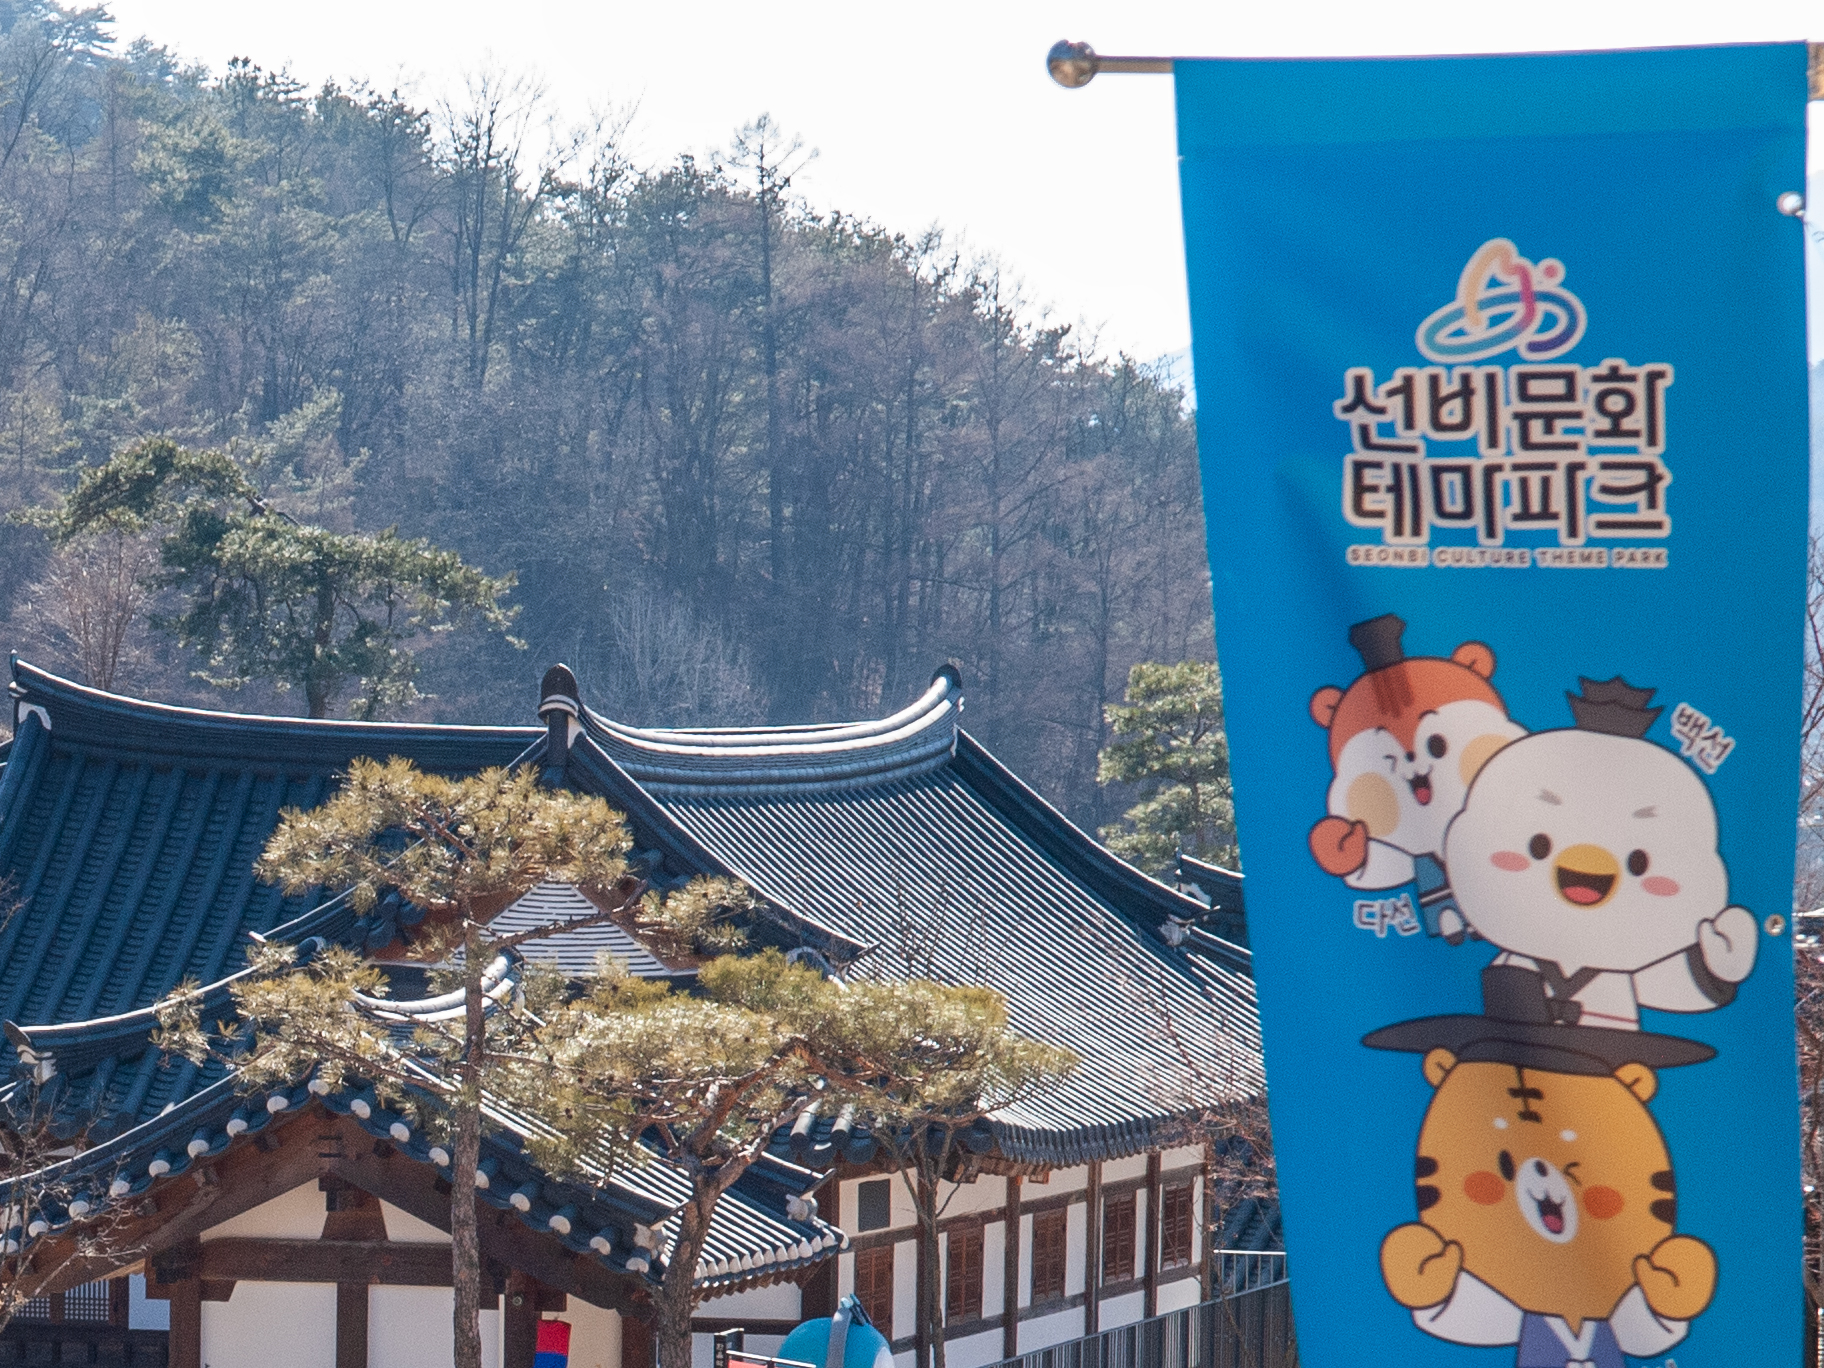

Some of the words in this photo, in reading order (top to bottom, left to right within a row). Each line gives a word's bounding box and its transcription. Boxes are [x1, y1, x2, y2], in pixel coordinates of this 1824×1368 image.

[1336, 360, 1672, 456] 선비문화
[1346, 457, 1670, 543] 테마파크
[1349, 549, 1428, 566] SEONBI
[1434, 549, 1530, 566] CULTURE
[1536, 549, 1608, 567] THEME
[1614, 550, 1667, 568] PARK
[1673, 703, 1734, 772] 백선
[1354, 894, 1420, 938] 다선
